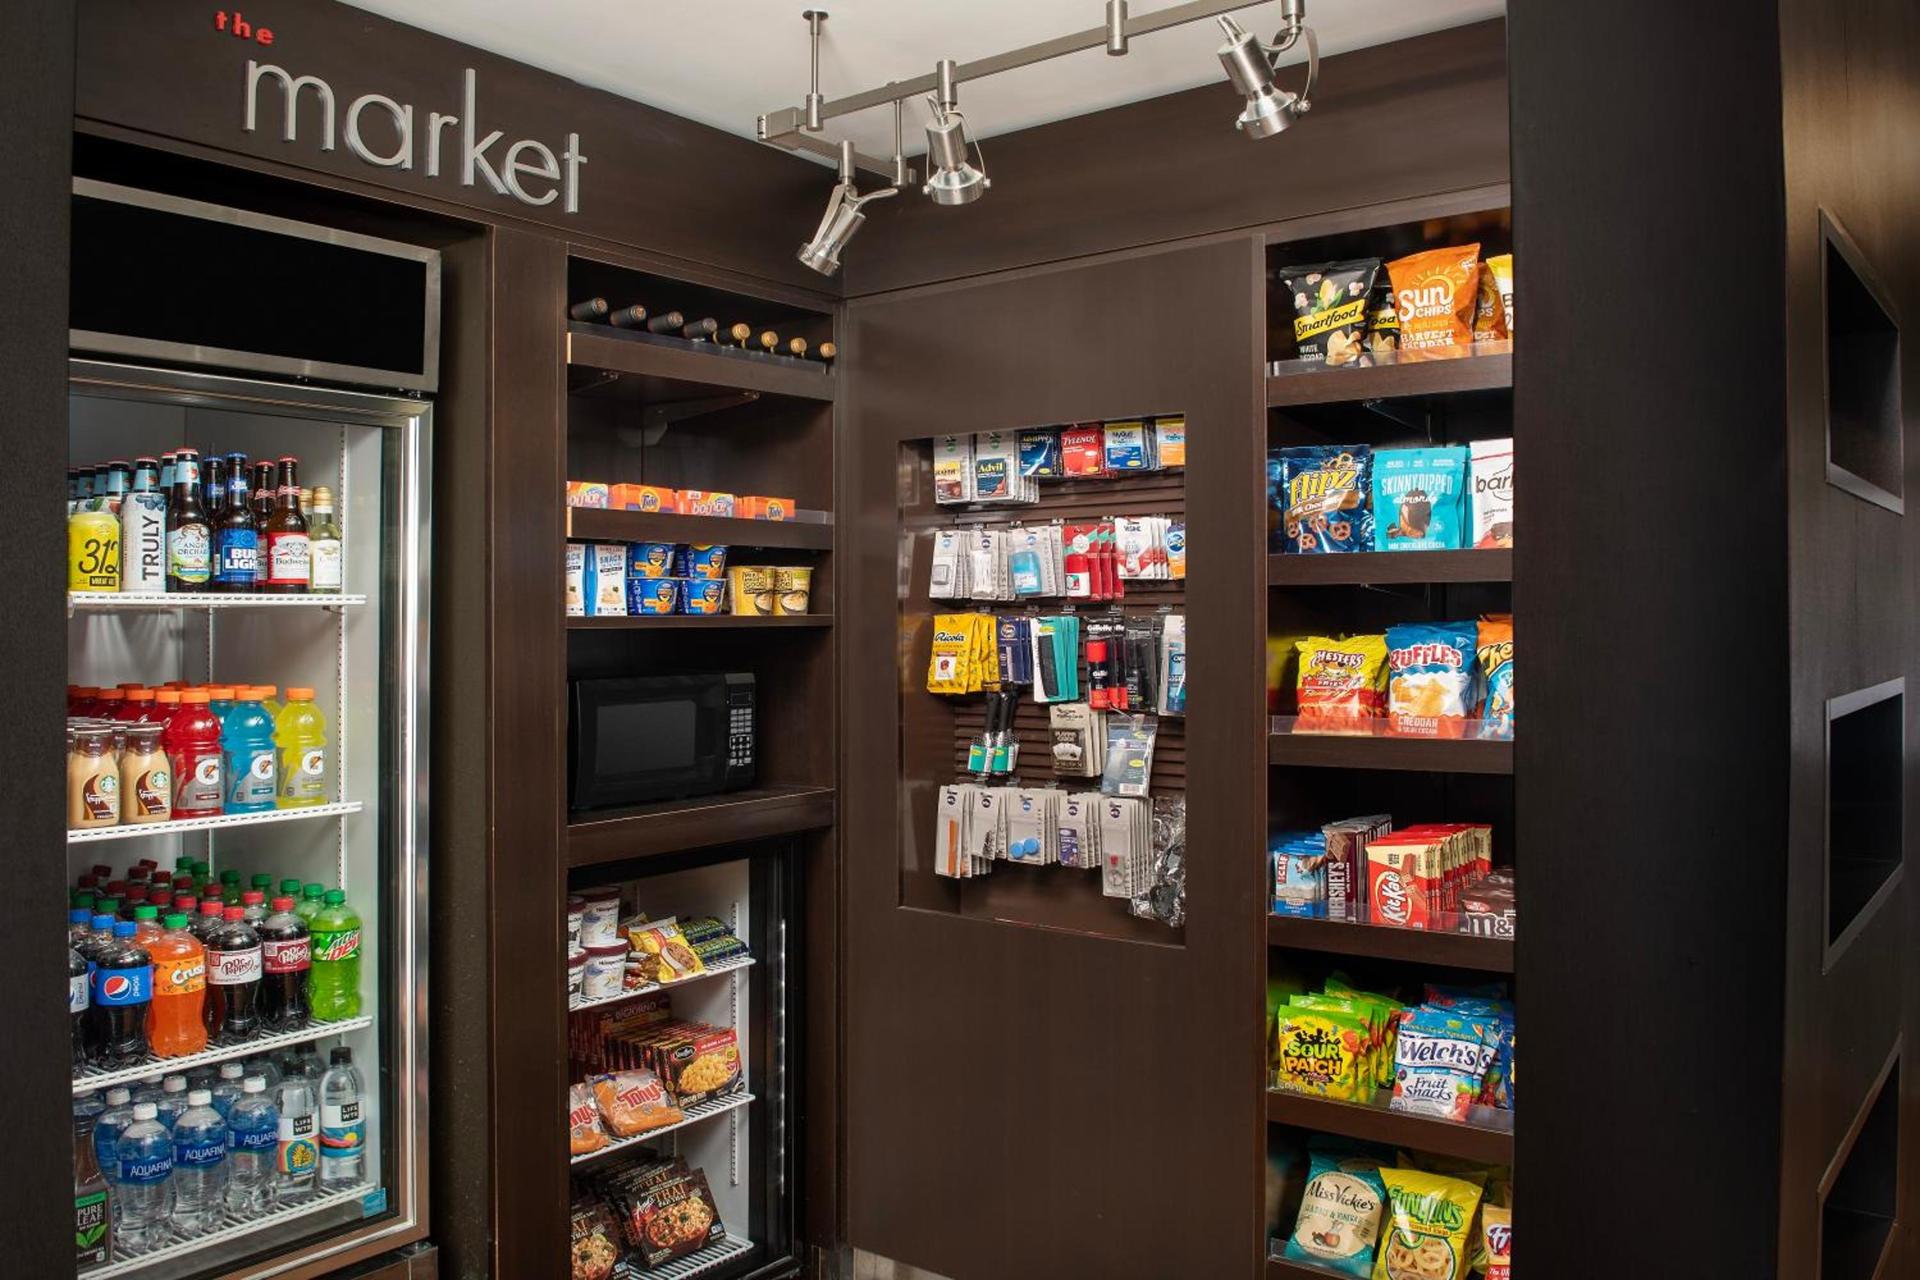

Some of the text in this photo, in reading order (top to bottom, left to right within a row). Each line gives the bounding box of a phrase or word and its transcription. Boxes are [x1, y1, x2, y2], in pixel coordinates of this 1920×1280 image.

[215, 11, 274, 46] the
[243, 59, 588, 213] market
[1296, 305, 1358, 337] Smartfood
[1415, 305, 1452, 318] CHIPS
[978, 462, 1003, 473] Advil
[142, 514, 160, 581] TRULY
[934, 631, 965, 642] Ricola
[1390, 644, 1462, 672] RUFFLES
[1328, 862, 1346, 917] HERSHEY'S
[1287, 1041, 1340, 1059] SOUR
[1400, 1040, 1477, 1067] Welch's
[1285, 1056, 1342, 1075] PATCH
[1414, 1077, 1448, 1089] Fruit
[1405, 1085, 1453, 1101] Snacks
[1334, 1184, 1376, 1213] Vickie's
[77, 1202, 104, 1218] PURE
[77, 1210, 104, 1226] LEAF
